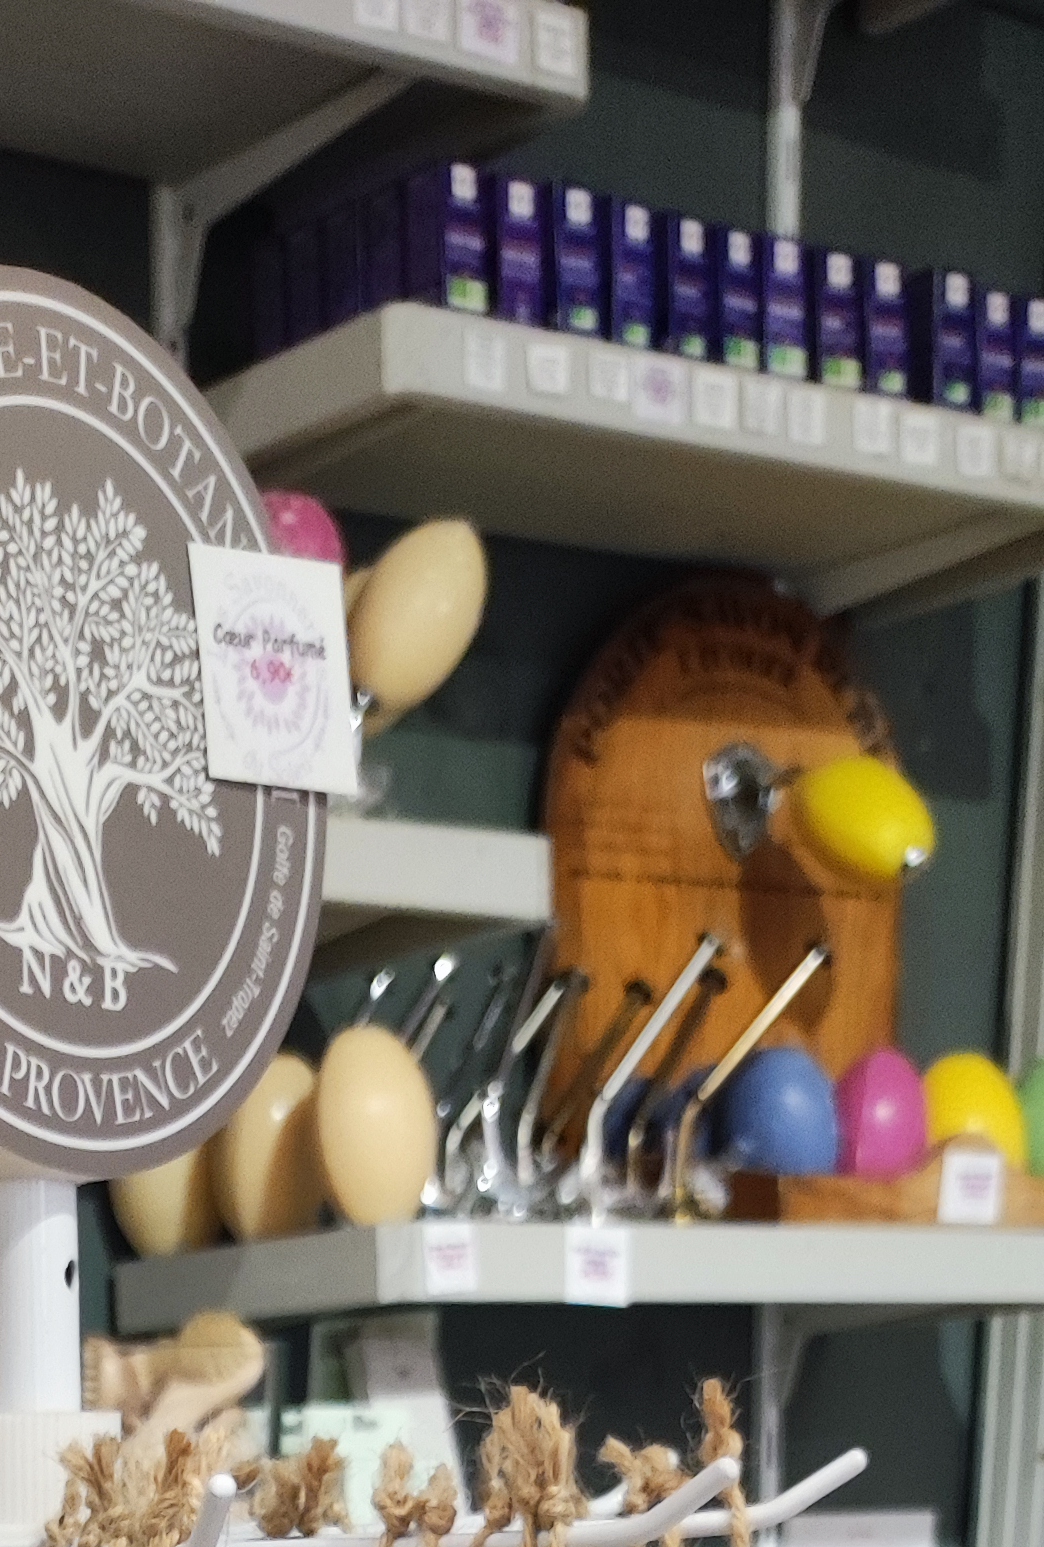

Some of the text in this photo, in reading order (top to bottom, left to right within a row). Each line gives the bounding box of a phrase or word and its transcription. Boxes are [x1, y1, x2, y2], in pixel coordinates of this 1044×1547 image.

[213, 623, 326, 661] Cœur Parfumé
[19, 946, 129, 1012] N & B
